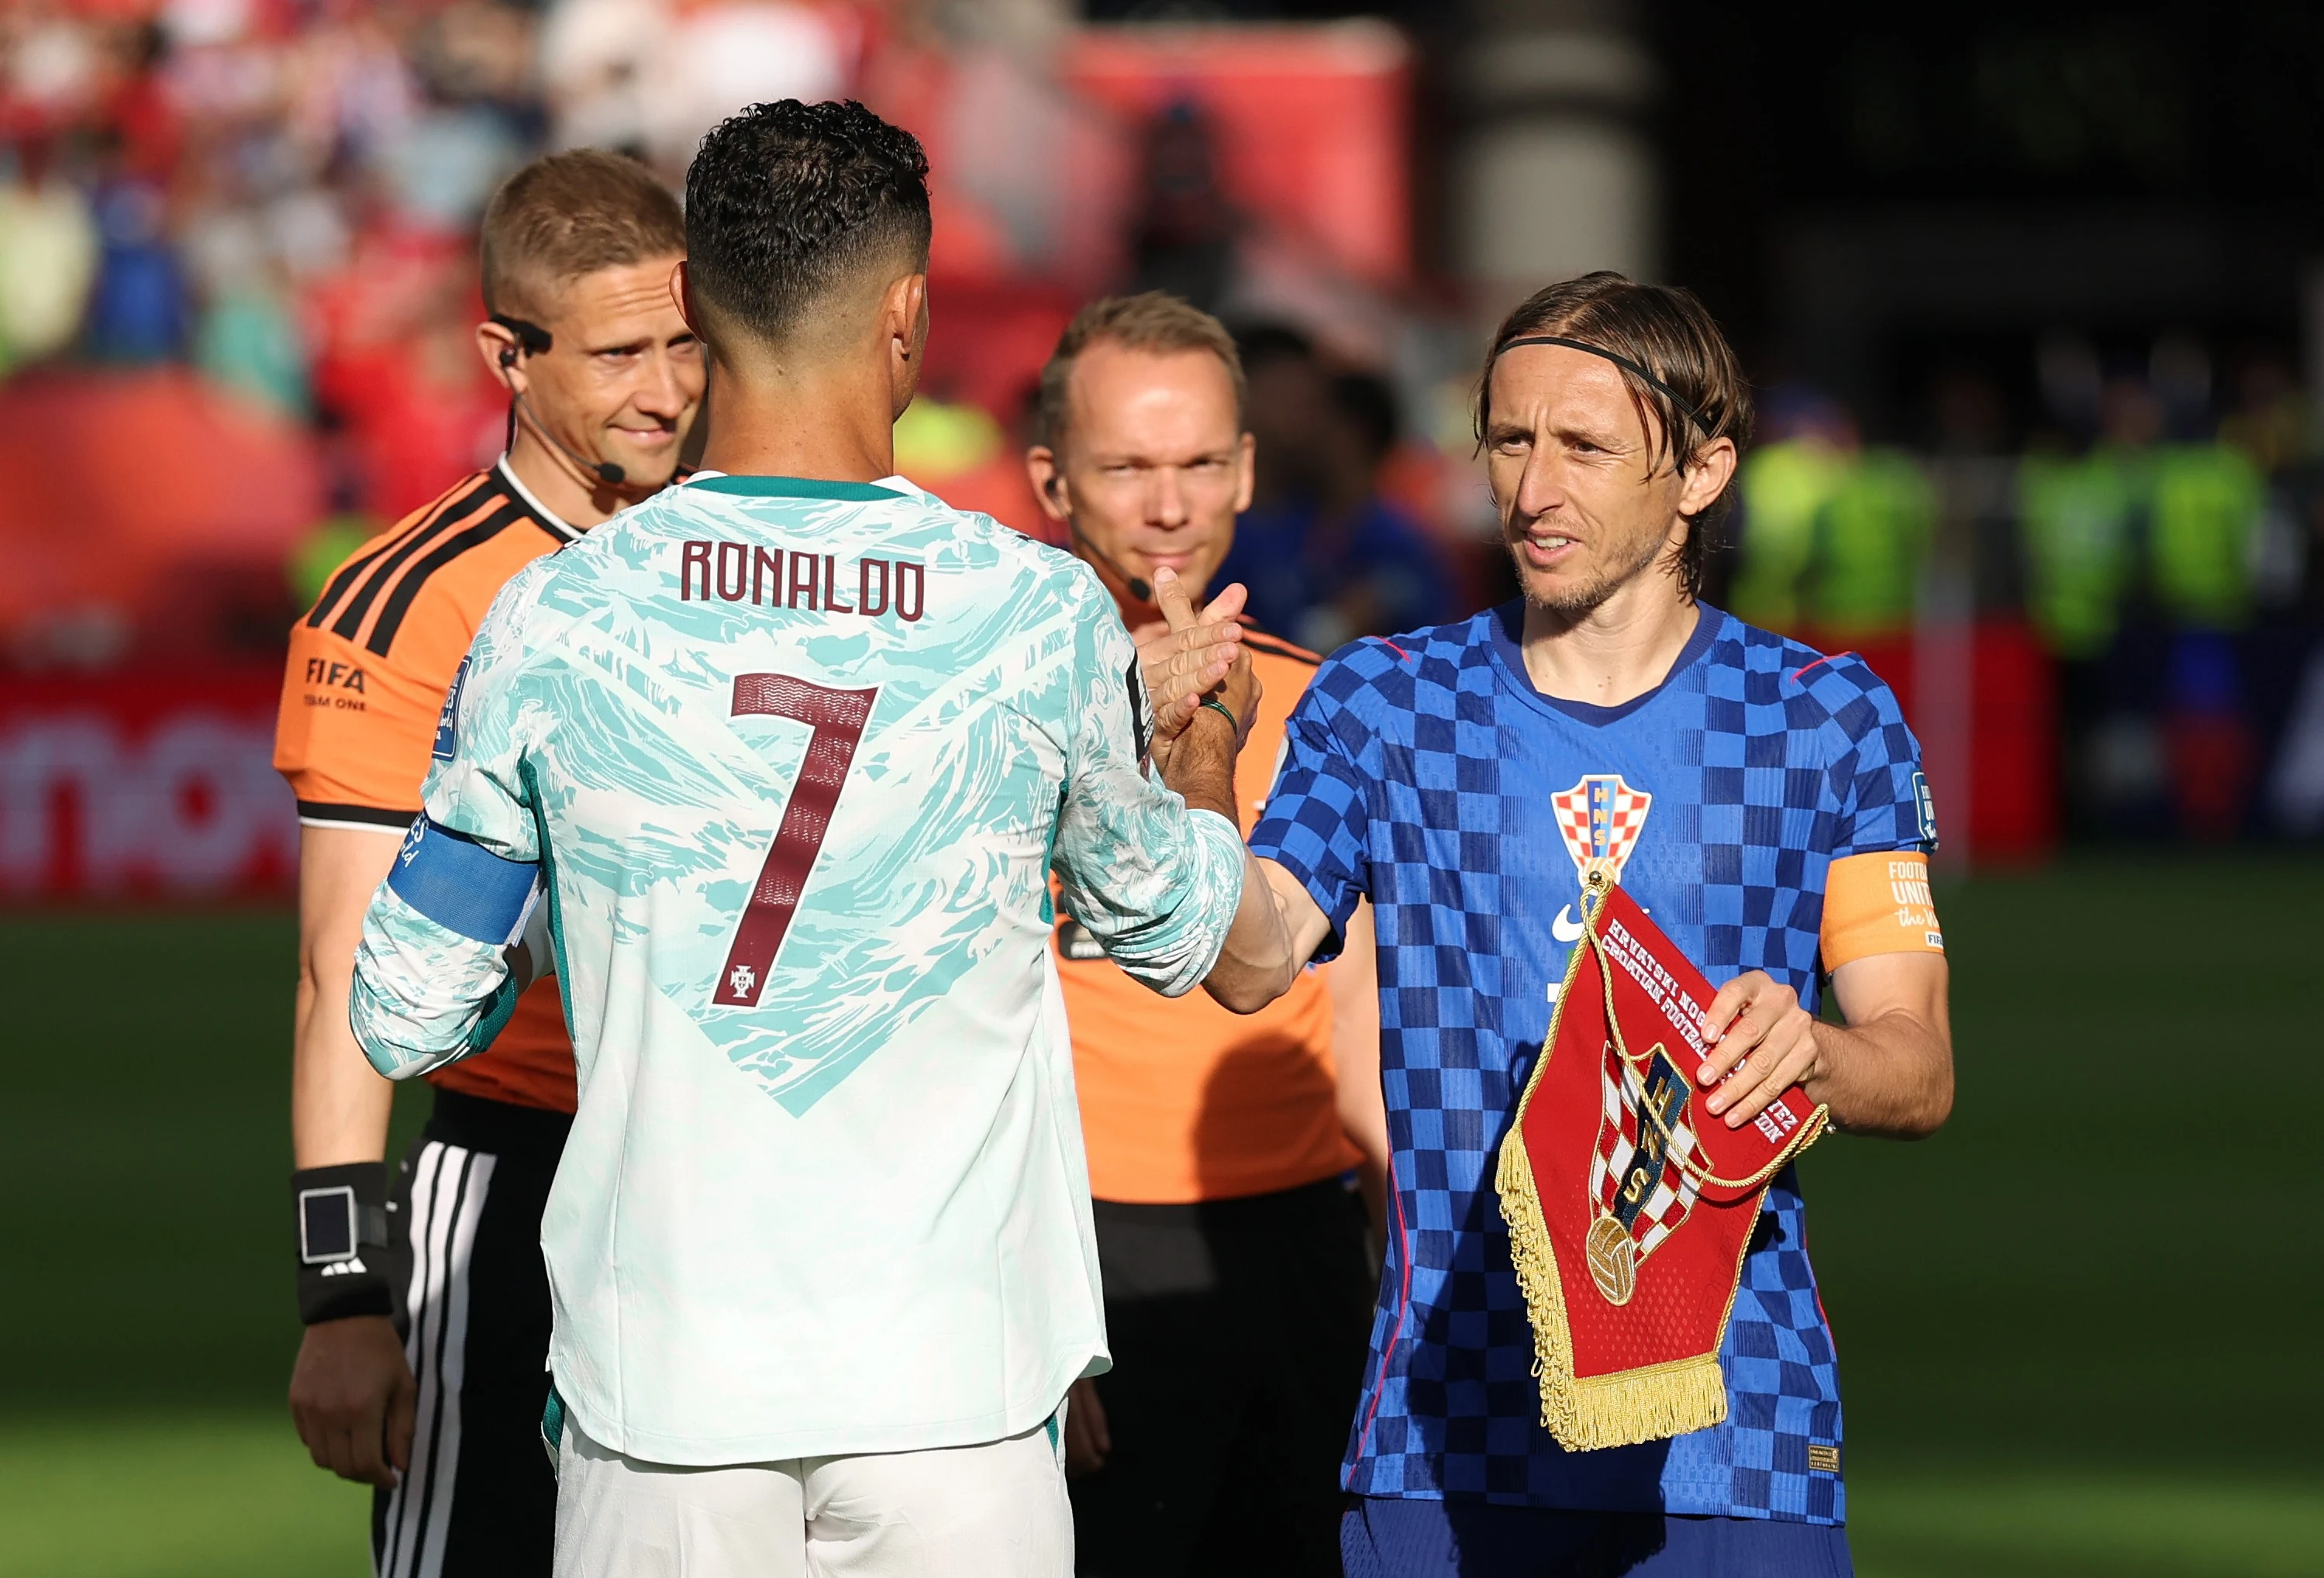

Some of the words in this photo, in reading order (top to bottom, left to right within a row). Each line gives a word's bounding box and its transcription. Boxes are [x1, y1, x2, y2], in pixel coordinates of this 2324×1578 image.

[681, 540, 925, 622] RONALDO
[305, 658, 364, 694] FIFA
[712, 673, 880, 1007] 7
[1593, 787, 1609, 846] HNS
[1894, 907, 1925, 927] the
[1608, 918, 1679, 997] HRVATSKI
[1602, 935, 1666, 1004] CROATIAN
[1660, 997, 1711, 1061] FOOTBAL
